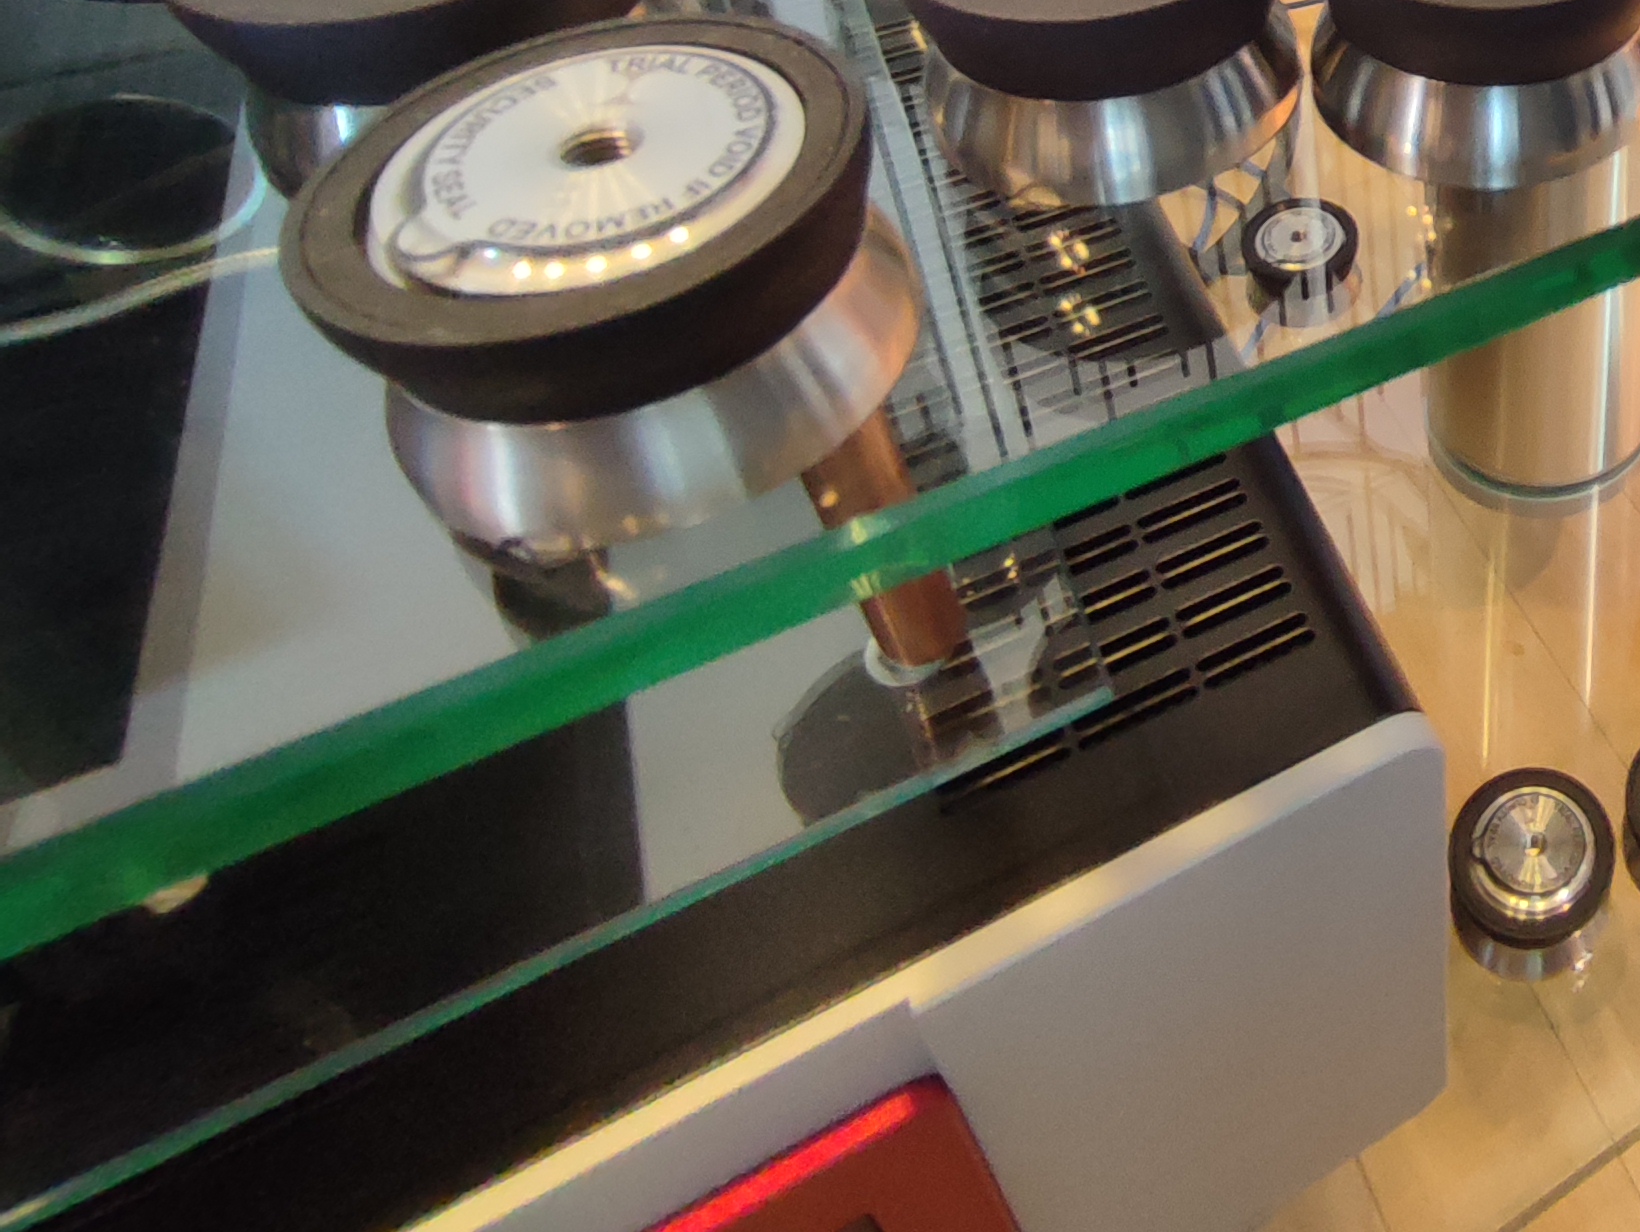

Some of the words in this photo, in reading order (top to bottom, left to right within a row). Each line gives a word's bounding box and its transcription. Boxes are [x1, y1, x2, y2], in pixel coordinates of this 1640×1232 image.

[609, 55, 691, 76] TRIAL
[695, 63, 764, 122] PERIOD
[708, 125, 762, 178] VOID
[487, 195, 676, 244] REMOVED
